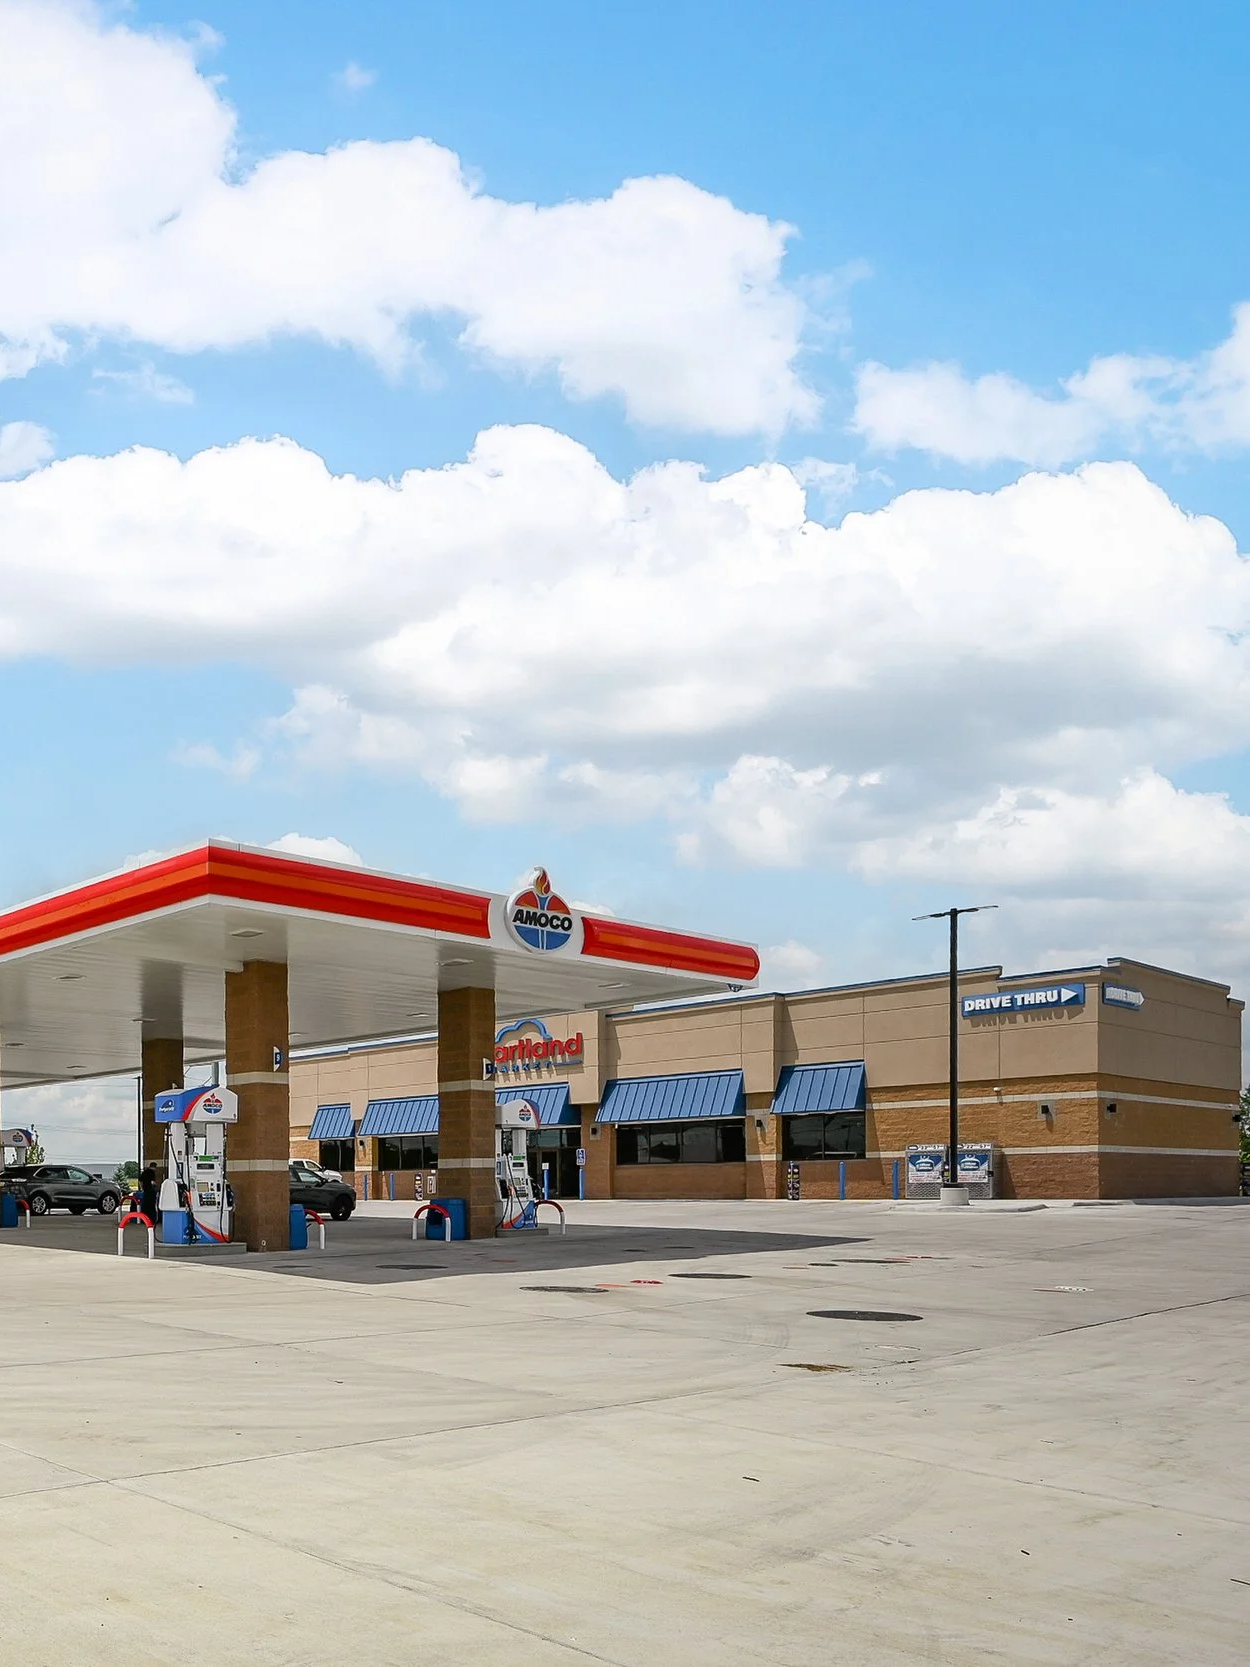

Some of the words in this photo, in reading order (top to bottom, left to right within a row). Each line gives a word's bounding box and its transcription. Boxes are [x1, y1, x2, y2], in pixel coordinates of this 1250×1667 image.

[512, 909, 572, 931] AMOCO
[964, 995, 1012, 1012] DRIVE
[1014, 990, 1058, 1006] THRU
[494, 1032, 583, 1062] artland
[495, 1061, 552, 1074] ARKET
